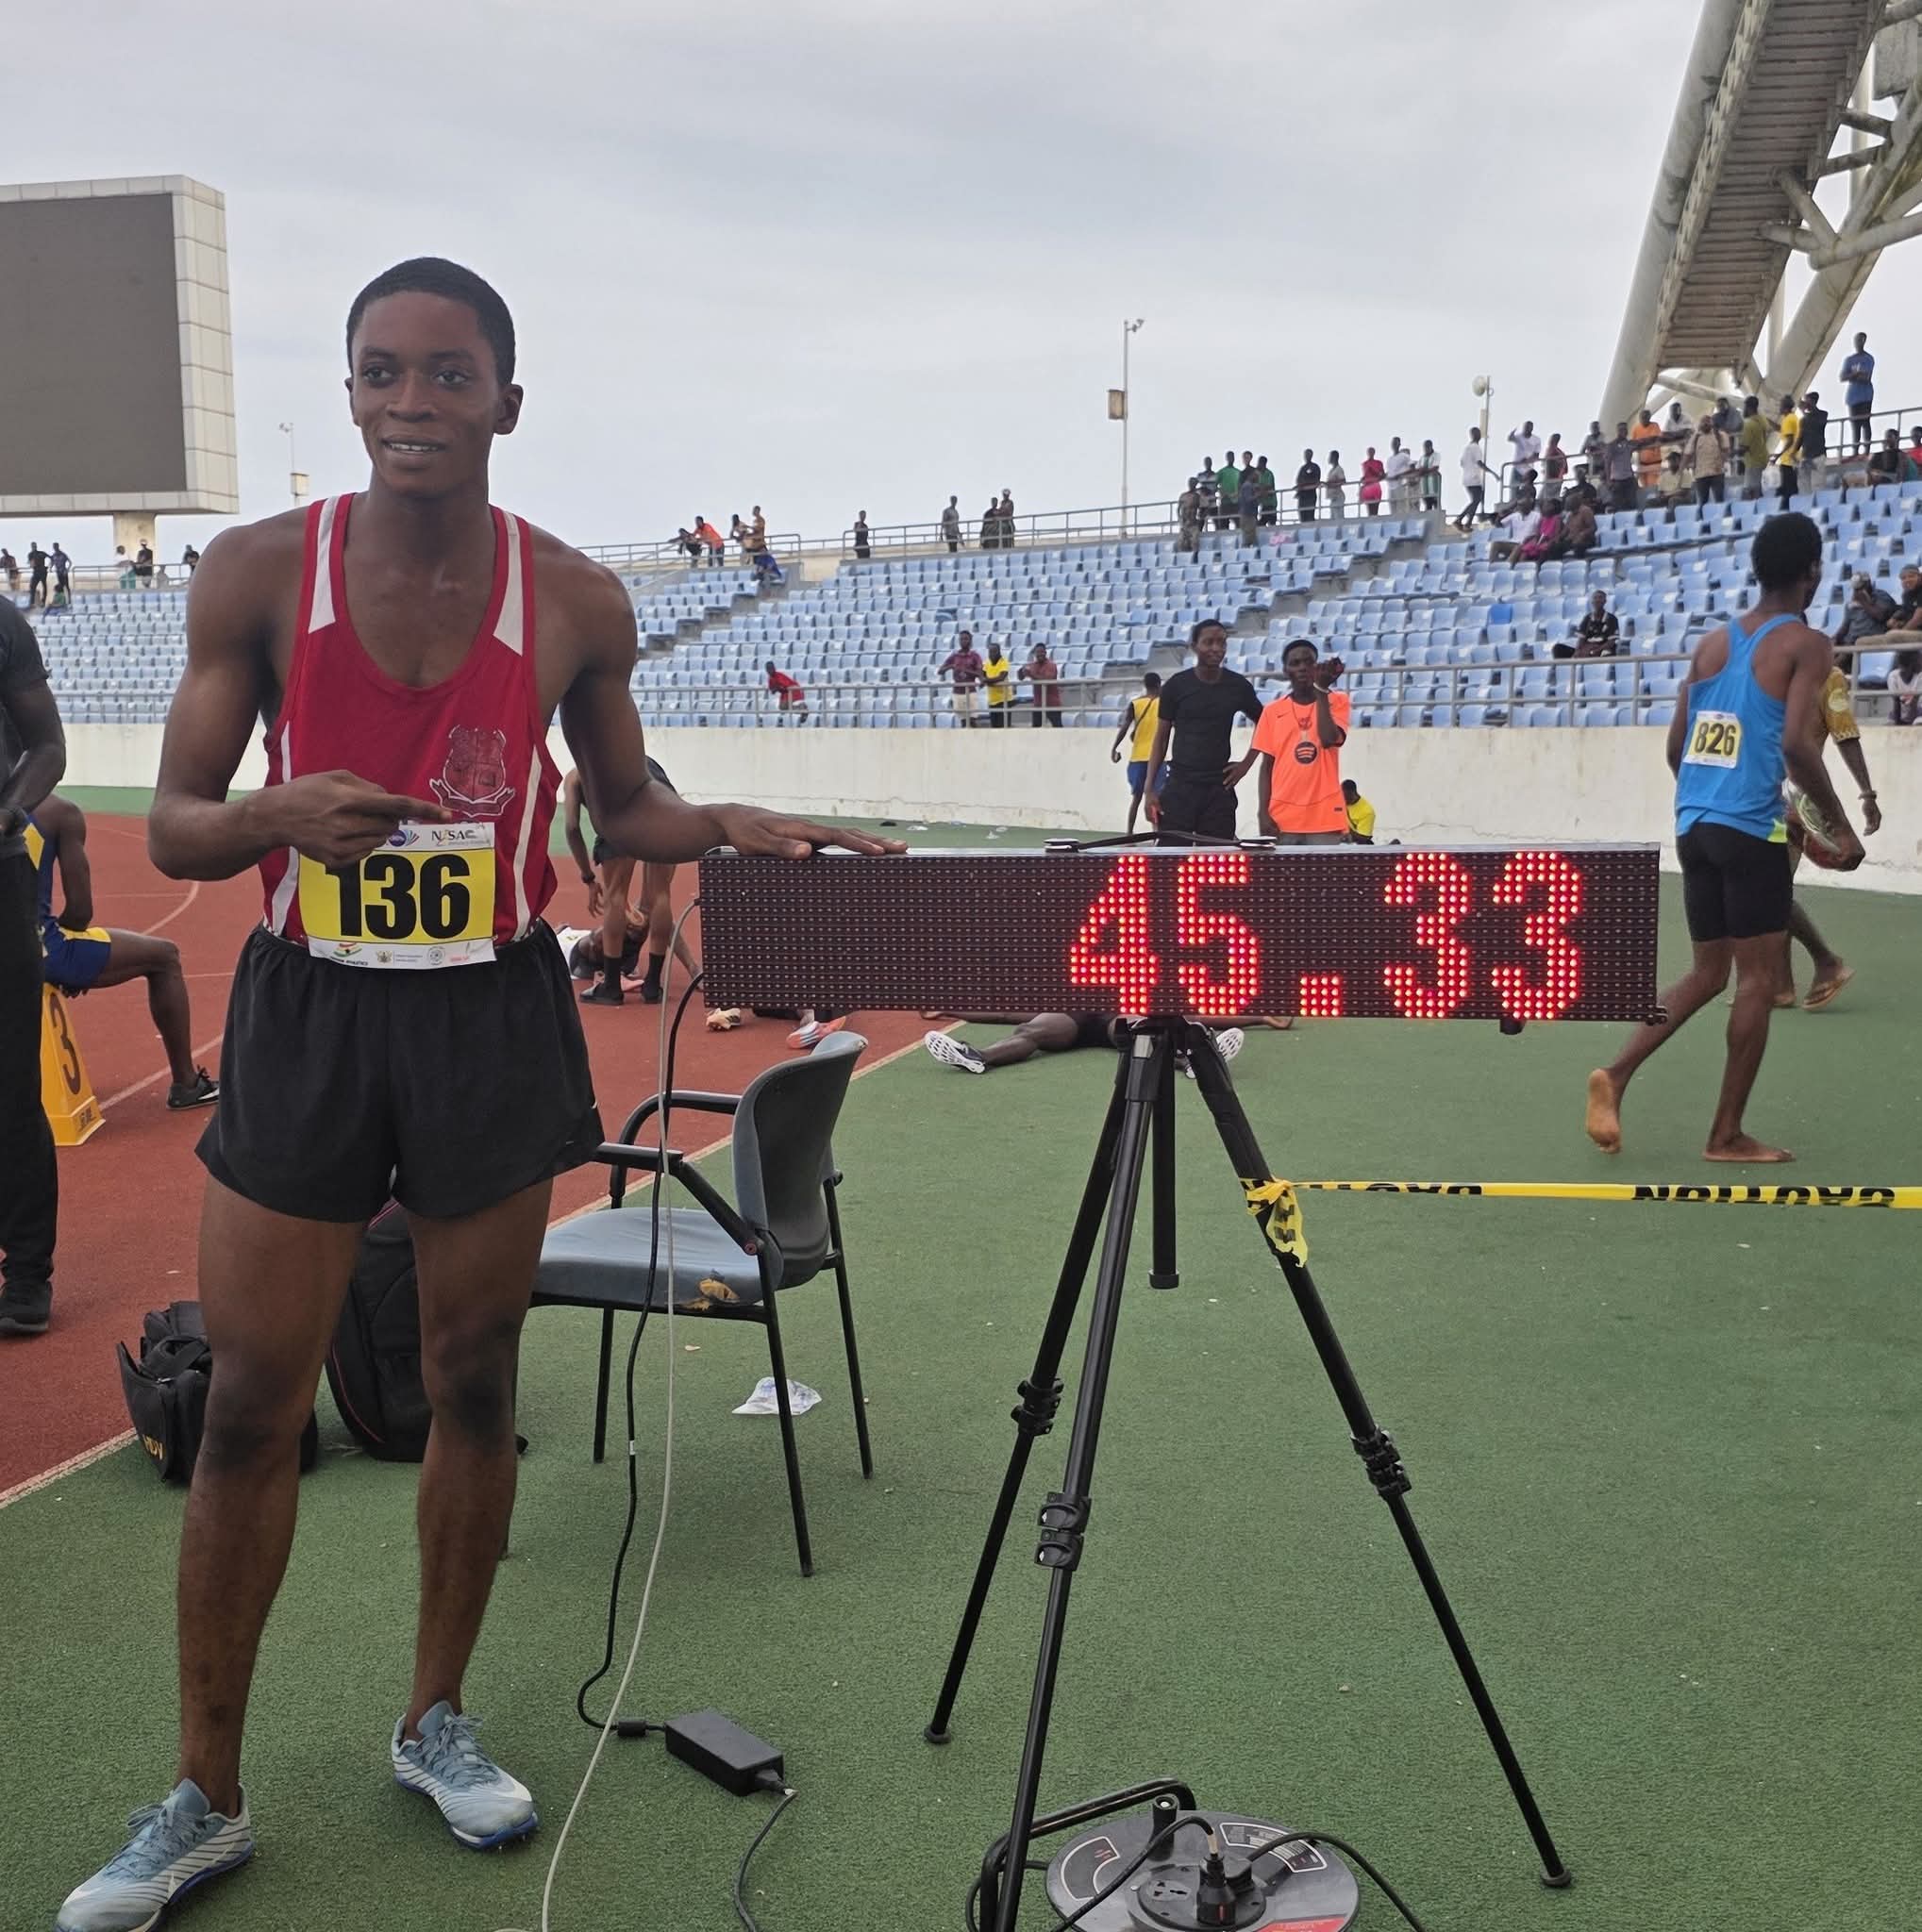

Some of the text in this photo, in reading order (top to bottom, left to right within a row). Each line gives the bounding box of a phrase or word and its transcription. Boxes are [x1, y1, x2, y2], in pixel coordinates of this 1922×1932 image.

[1694, 722, 1736, 757] 826
[325, 853, 470, 940] 136
[1069, 852, 1582, 1020] 45.33
[49, 991, 81, 1095] 3
